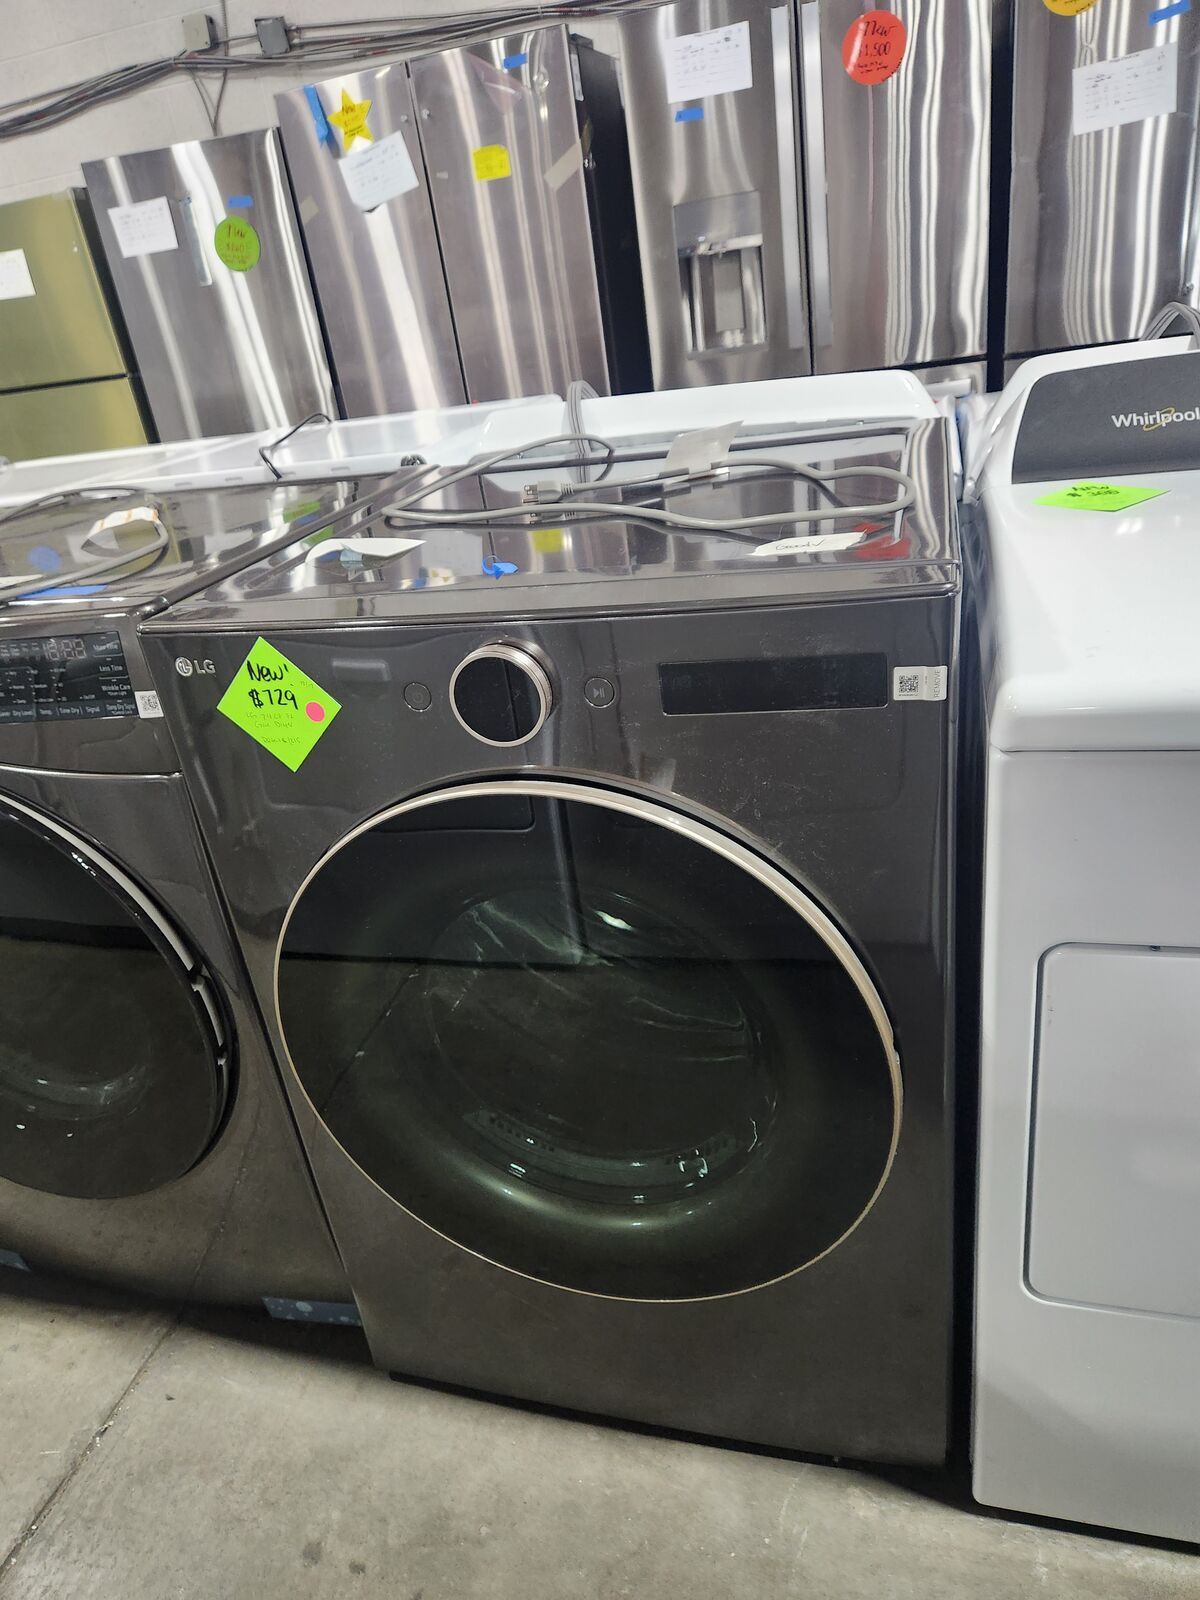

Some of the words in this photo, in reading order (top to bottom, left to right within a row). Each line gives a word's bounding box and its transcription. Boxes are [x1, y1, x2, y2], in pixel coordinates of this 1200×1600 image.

[1111, 407, 1200, 427] Whirlpool
[194, 659, 216, 675] LG
[933, 669, 941, 698] REMOVE
[248, 689, 299, 710] $729
